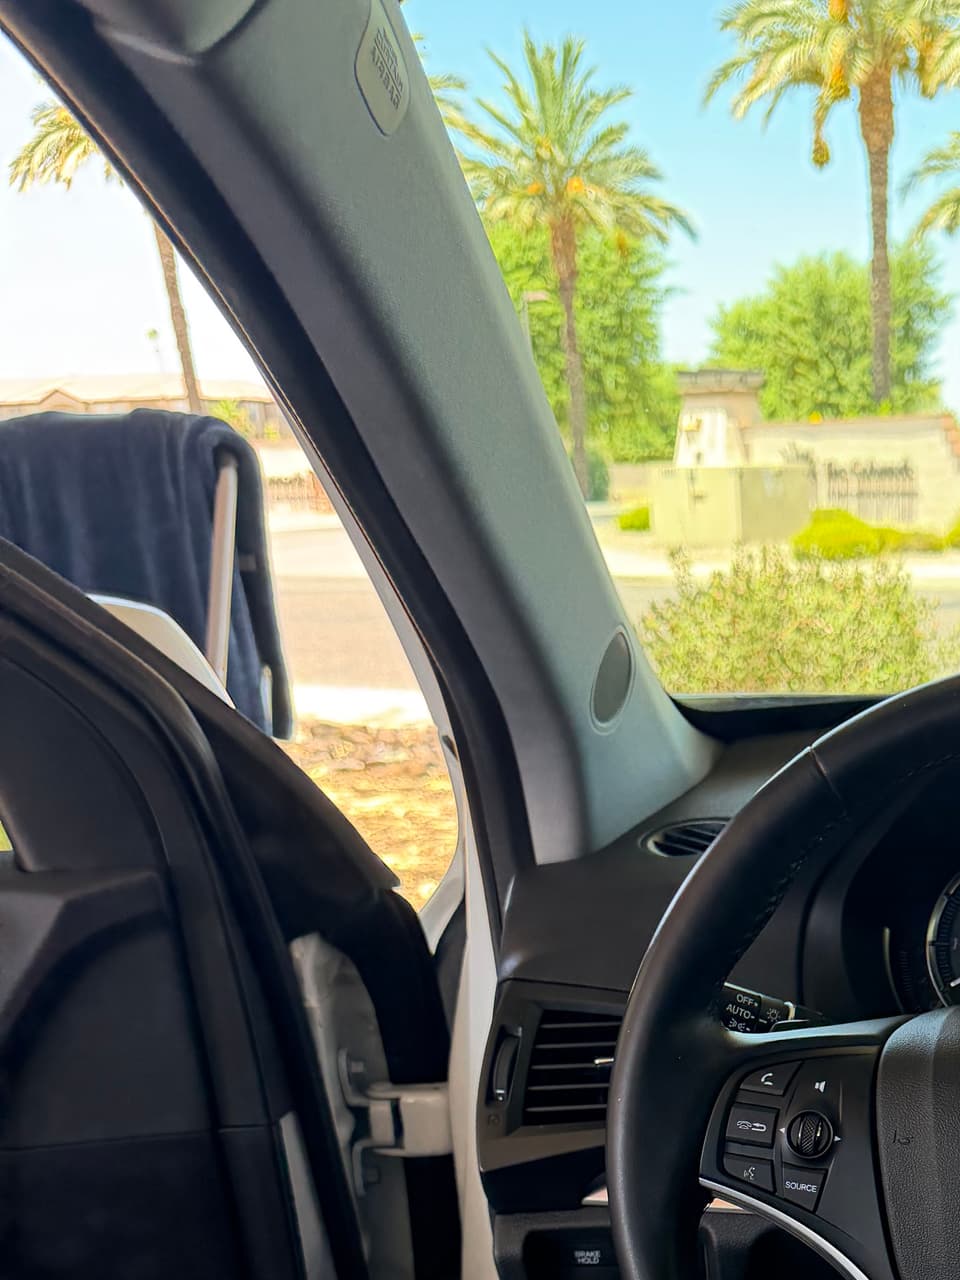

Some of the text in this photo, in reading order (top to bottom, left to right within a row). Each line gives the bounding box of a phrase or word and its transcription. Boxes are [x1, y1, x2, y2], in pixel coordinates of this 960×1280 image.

[736, 994, 754, 1006] OFF
[726, 1003, 752, 1020] AUTO
[785, 1180, 817, 1193] SOURCE
[574, 1250, 601, 1258] BRAKE
